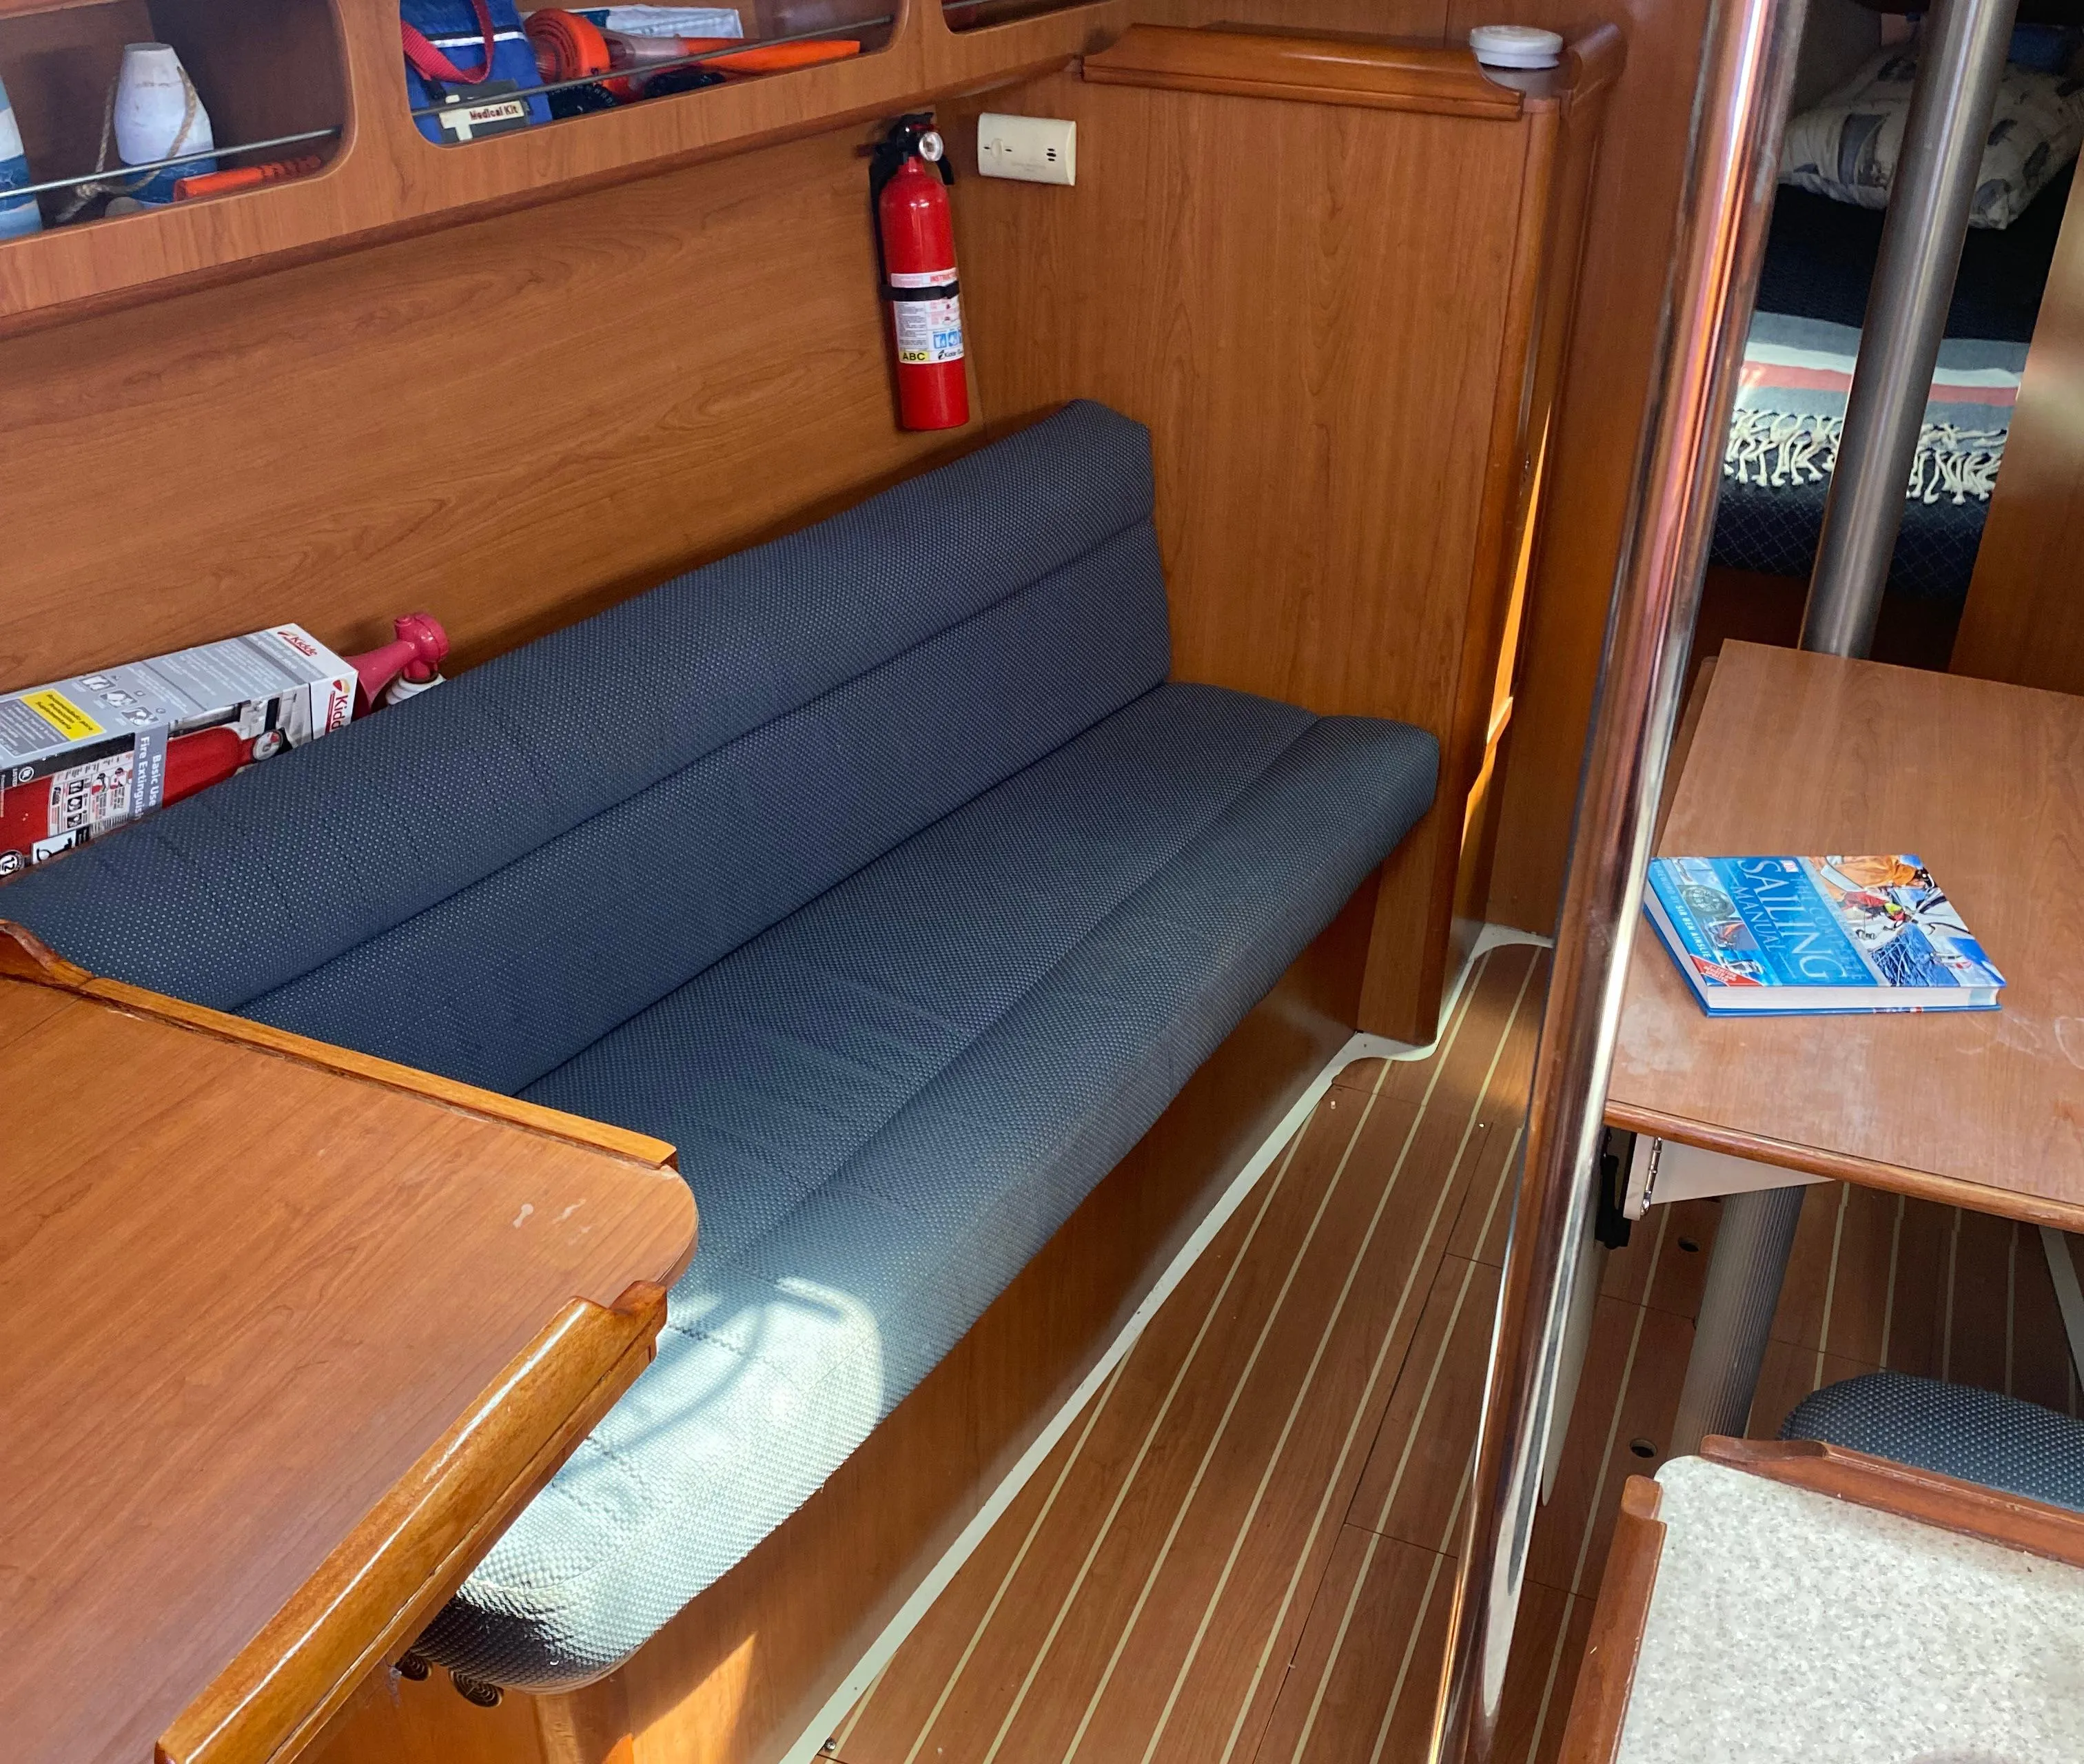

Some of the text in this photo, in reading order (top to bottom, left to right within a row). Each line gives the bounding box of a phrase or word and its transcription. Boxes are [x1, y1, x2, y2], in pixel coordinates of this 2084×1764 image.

[469, 103, 519, 121] Medical Kit
[903, 352, 926, 361] ABC
[290, 635, 318, 655] Kidde
[331, 695, 349, 730] Kidd
[134, 736, 150, 820] Fire Extinguish
[148, 755, 162, 807] Basic Use
[2, 857, 15, 872] 12
[1790, 875, 1818, 903] THE
[1675, 905, 1688, 916] SIR
[1682, 917, 1696, 931] BEN
[1690, 932, 1712, 958] AINSLIE
[1730, 886, 1786, 952] MANUAL
[1737, 860, 1847, 978] SAILING
